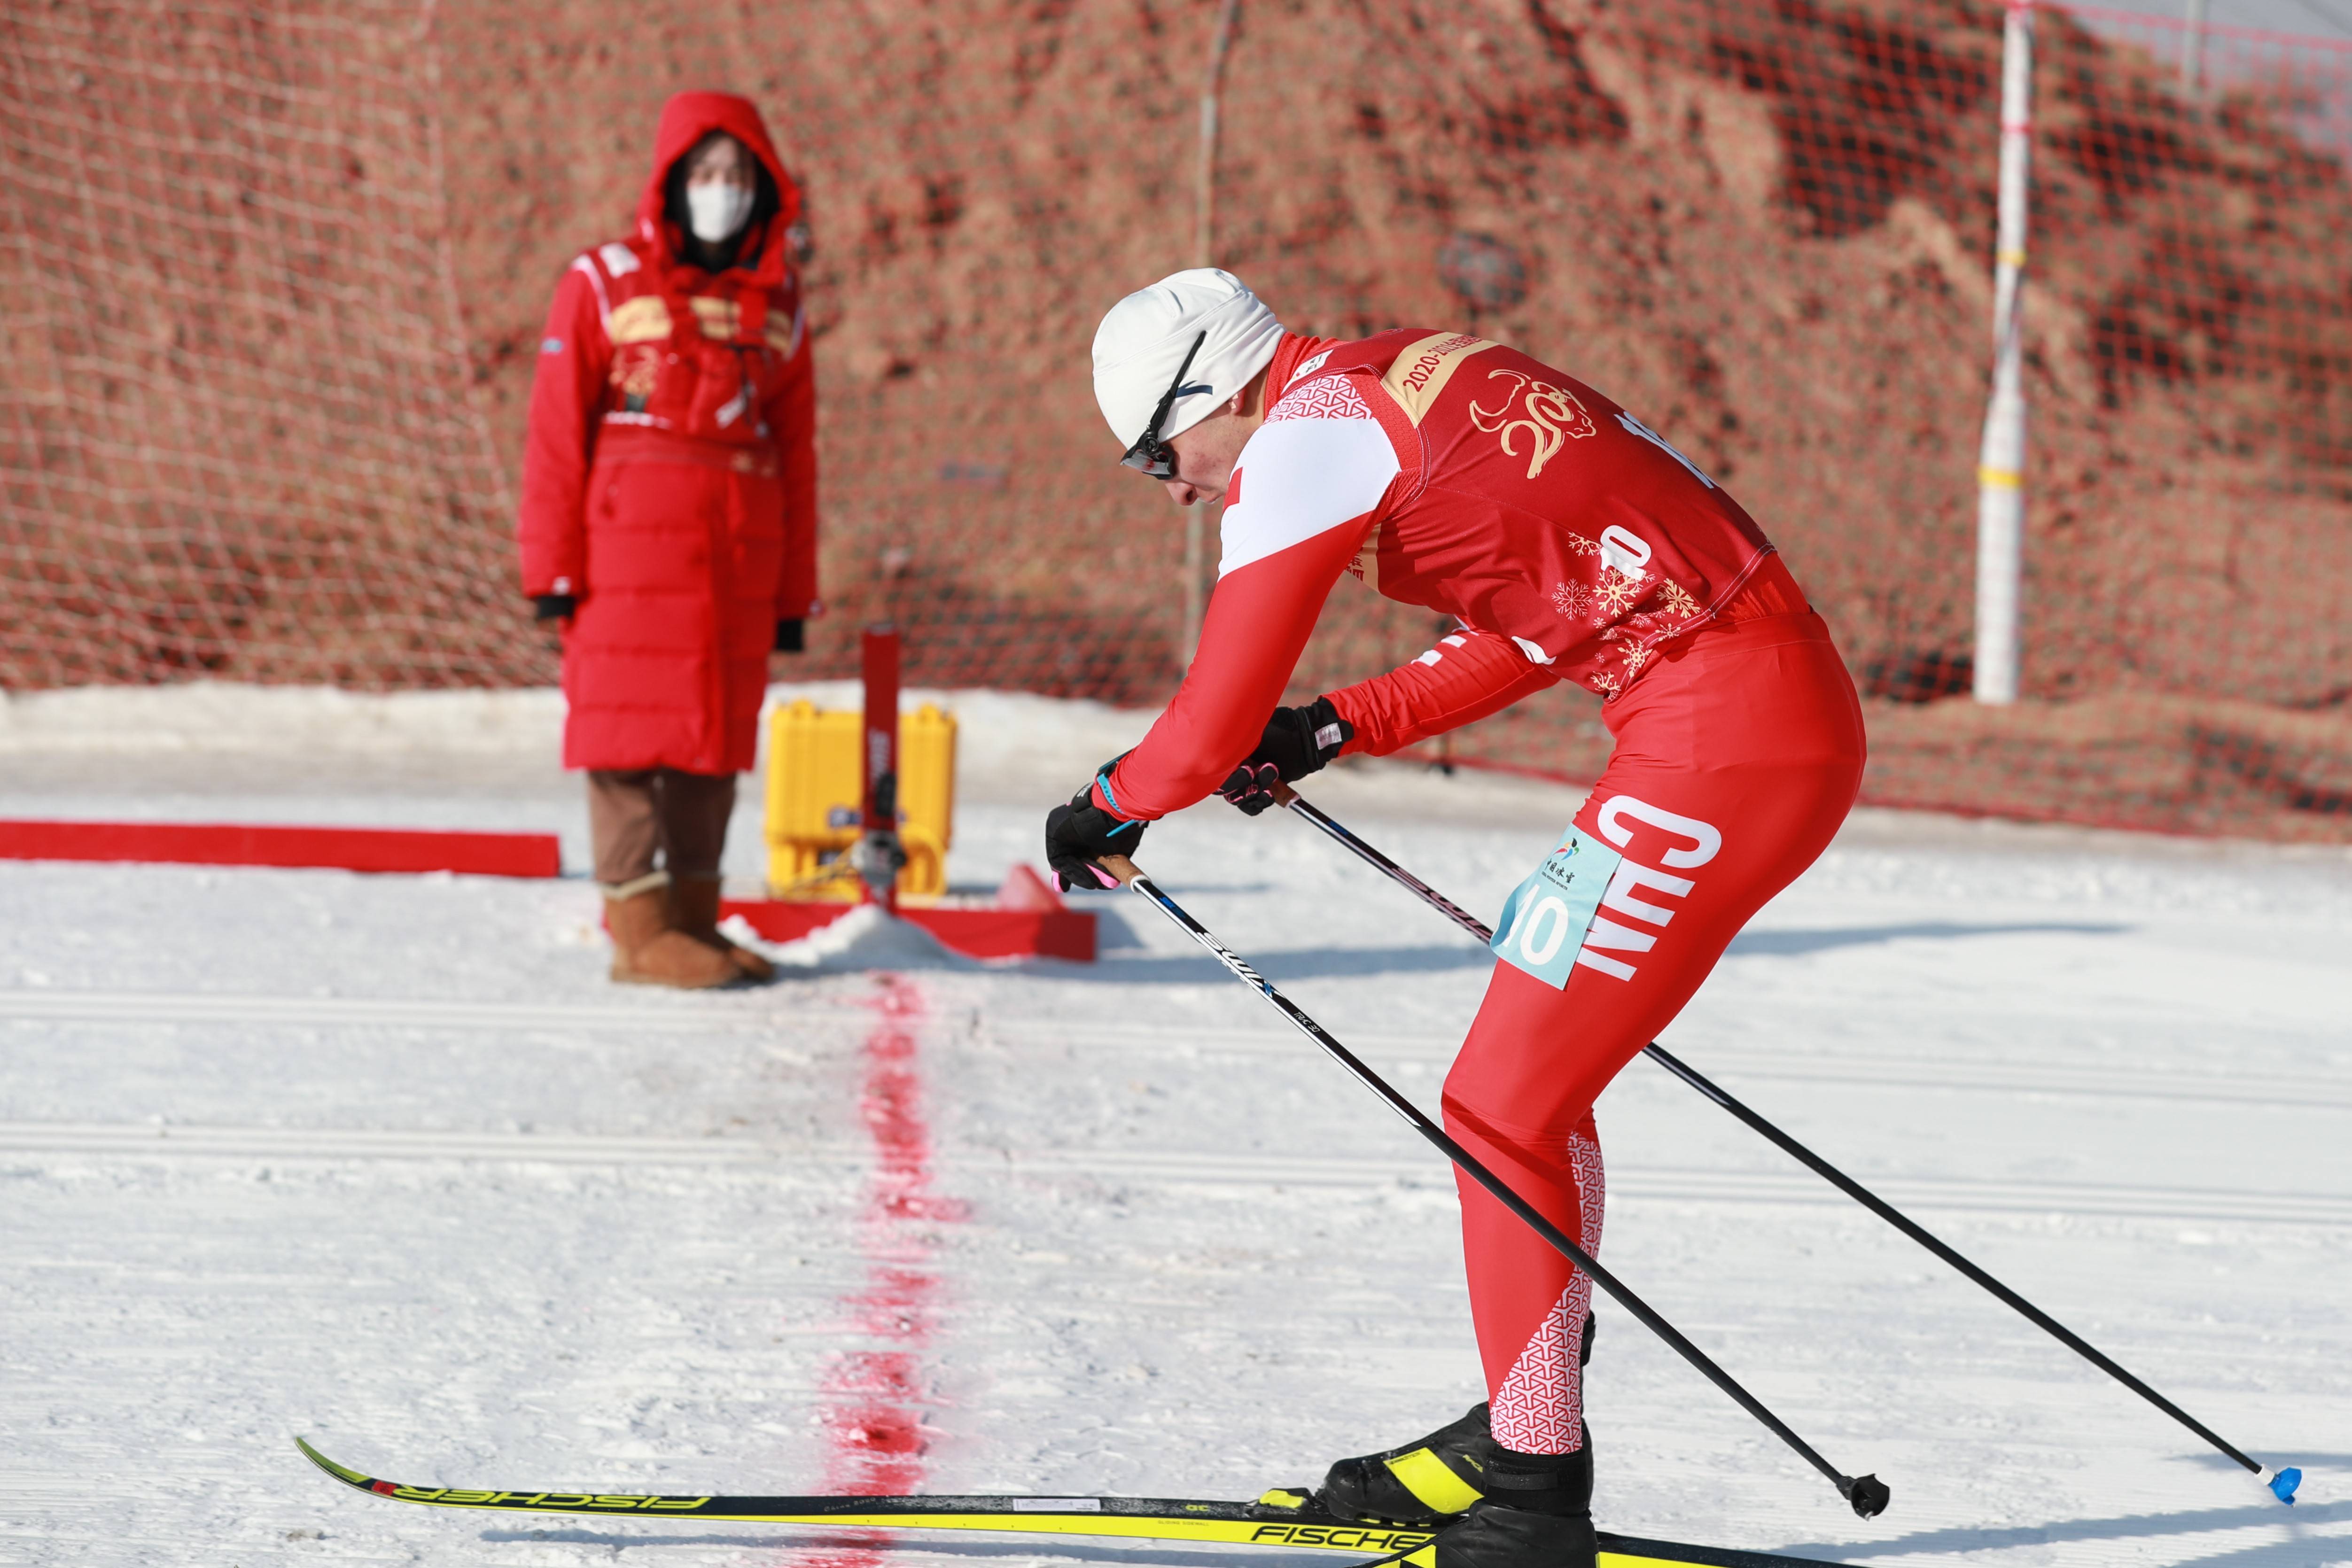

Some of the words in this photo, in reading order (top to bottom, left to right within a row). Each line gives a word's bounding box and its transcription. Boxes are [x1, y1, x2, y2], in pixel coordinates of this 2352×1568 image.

[1503, 884, 1569, 966] 10
[393, 1484, 711, 1509] FISCHER
[1250, 1525, 1436, 1550] FISCHE
